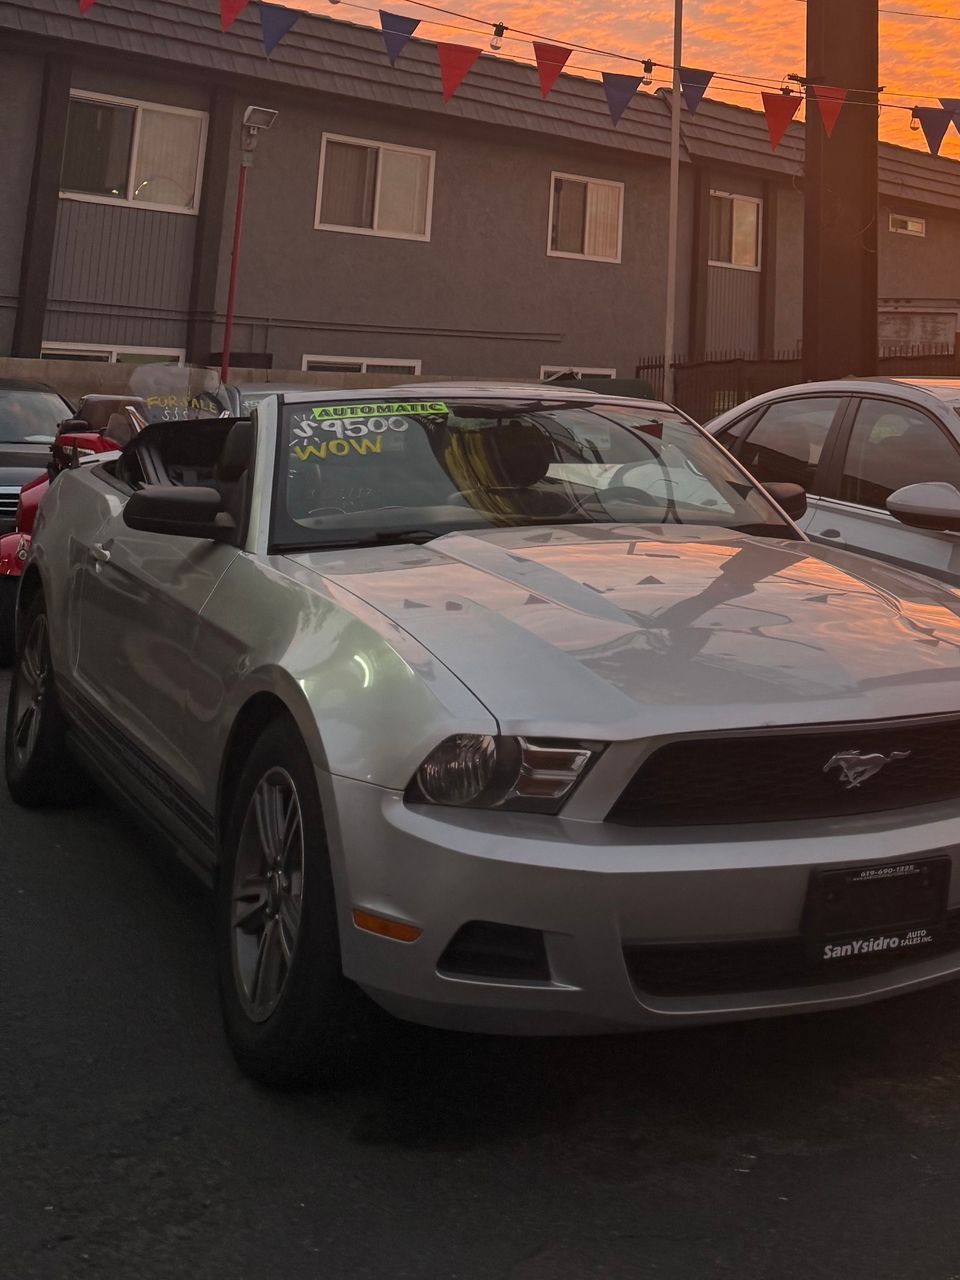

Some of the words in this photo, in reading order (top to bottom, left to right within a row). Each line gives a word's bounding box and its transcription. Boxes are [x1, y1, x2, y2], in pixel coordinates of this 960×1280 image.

[147, 395, 176, 409] FOR
[180, 398, 218, 414] SALE
[317, 403, 444, 418] AUTOMATIC
[293, 416, 409, 439] $9500
[294, 435, 383, 462] WOW
[900, 937, 921, 947] SALES
[906, 929, 927, 939] AUTO
[823, 937, 899, 959] SanYsidro
